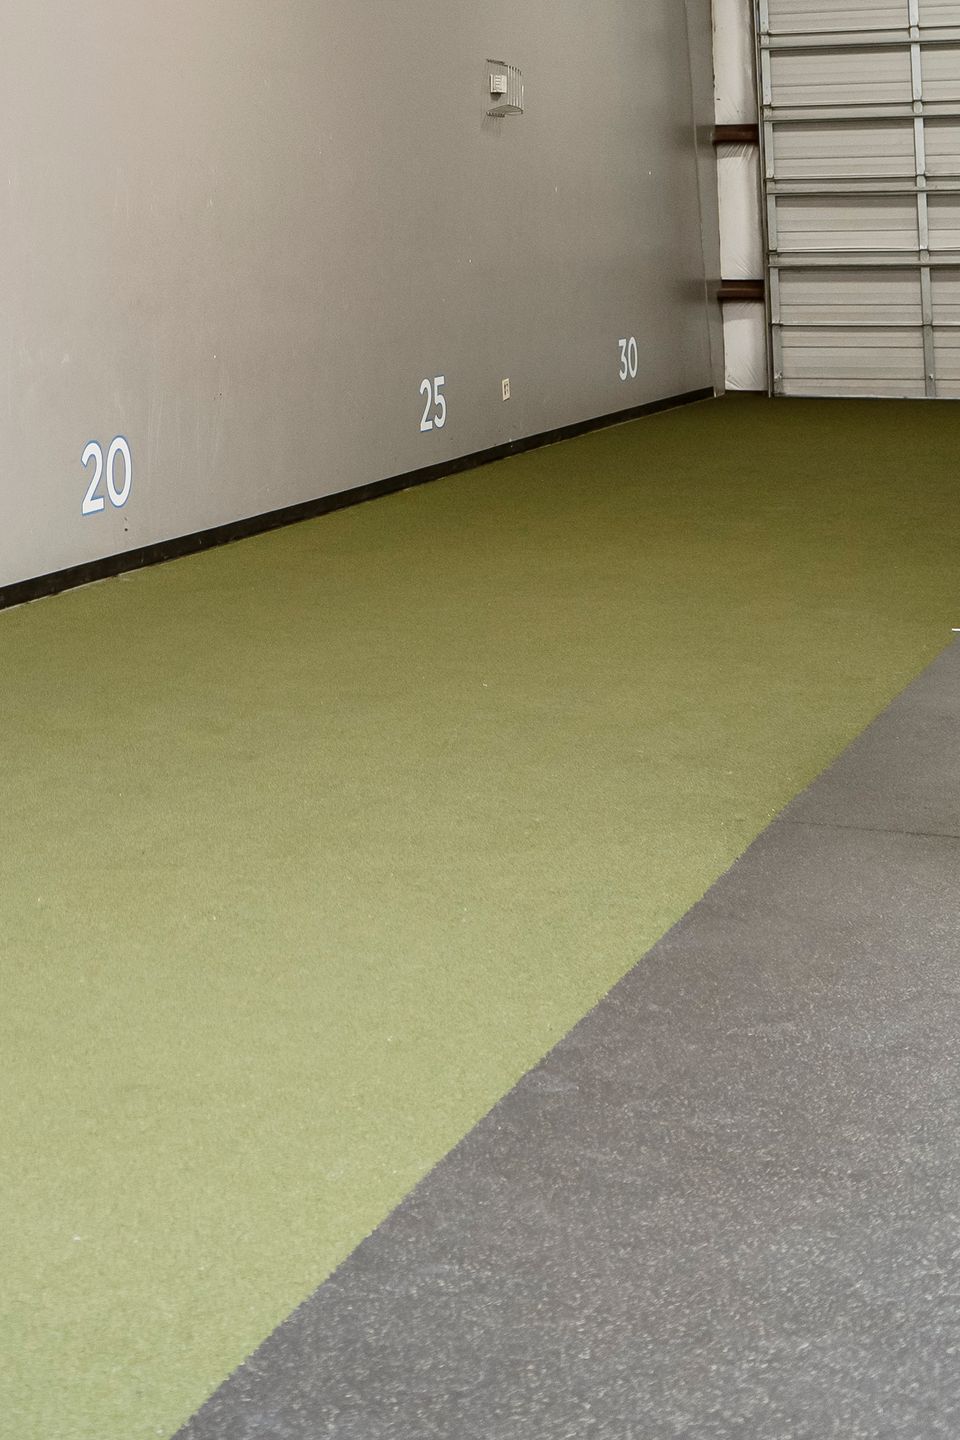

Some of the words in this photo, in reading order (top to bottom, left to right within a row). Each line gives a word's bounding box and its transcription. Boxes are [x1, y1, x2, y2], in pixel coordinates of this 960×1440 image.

[618, 336, 638, 381] 30
[419, 375, 447, 432] 25
[81, 435, 132, 516] 20
